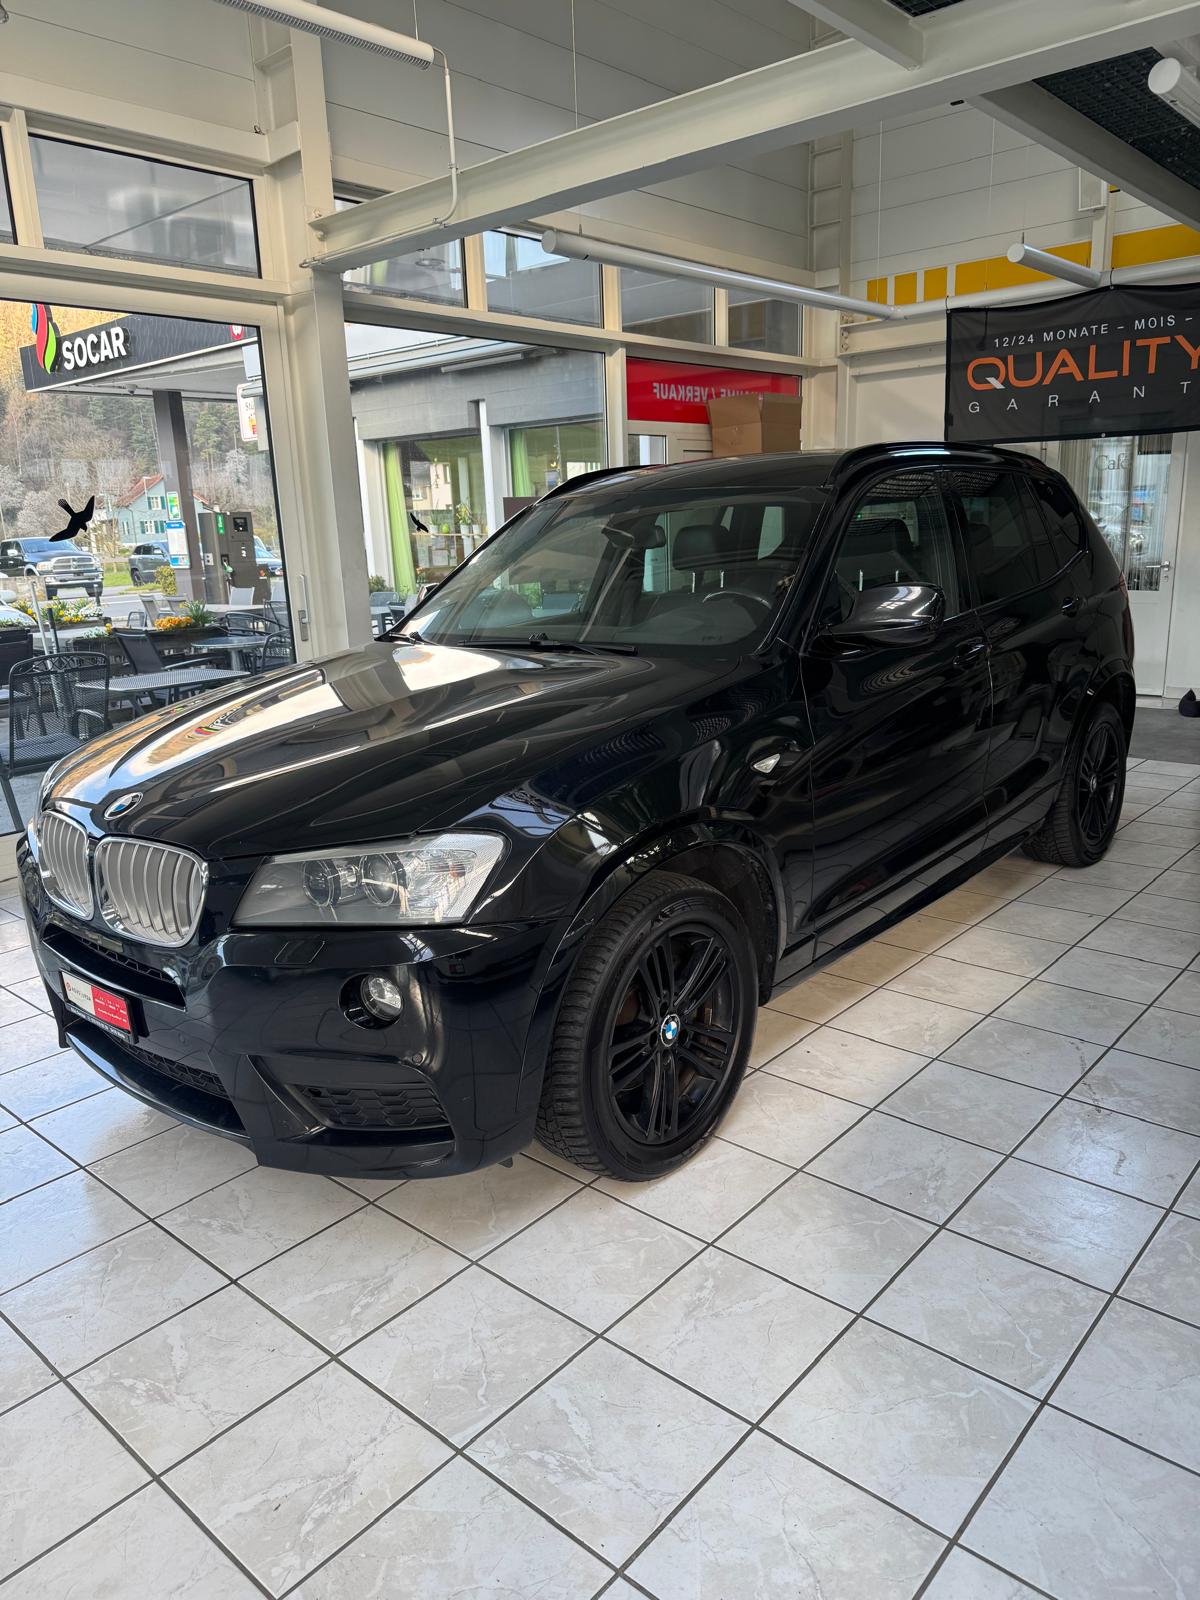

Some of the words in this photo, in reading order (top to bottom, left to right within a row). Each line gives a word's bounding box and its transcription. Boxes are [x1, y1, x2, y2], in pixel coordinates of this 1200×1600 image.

[62, 326, 127, 370] SOCAR
[994, 334, 1035, 348] 12/24
[1043, 323, 1110, 342] MONATE
[1134, 315, 1176, 330] MOIS
[967, 334, 1200, 391] QUALITY
